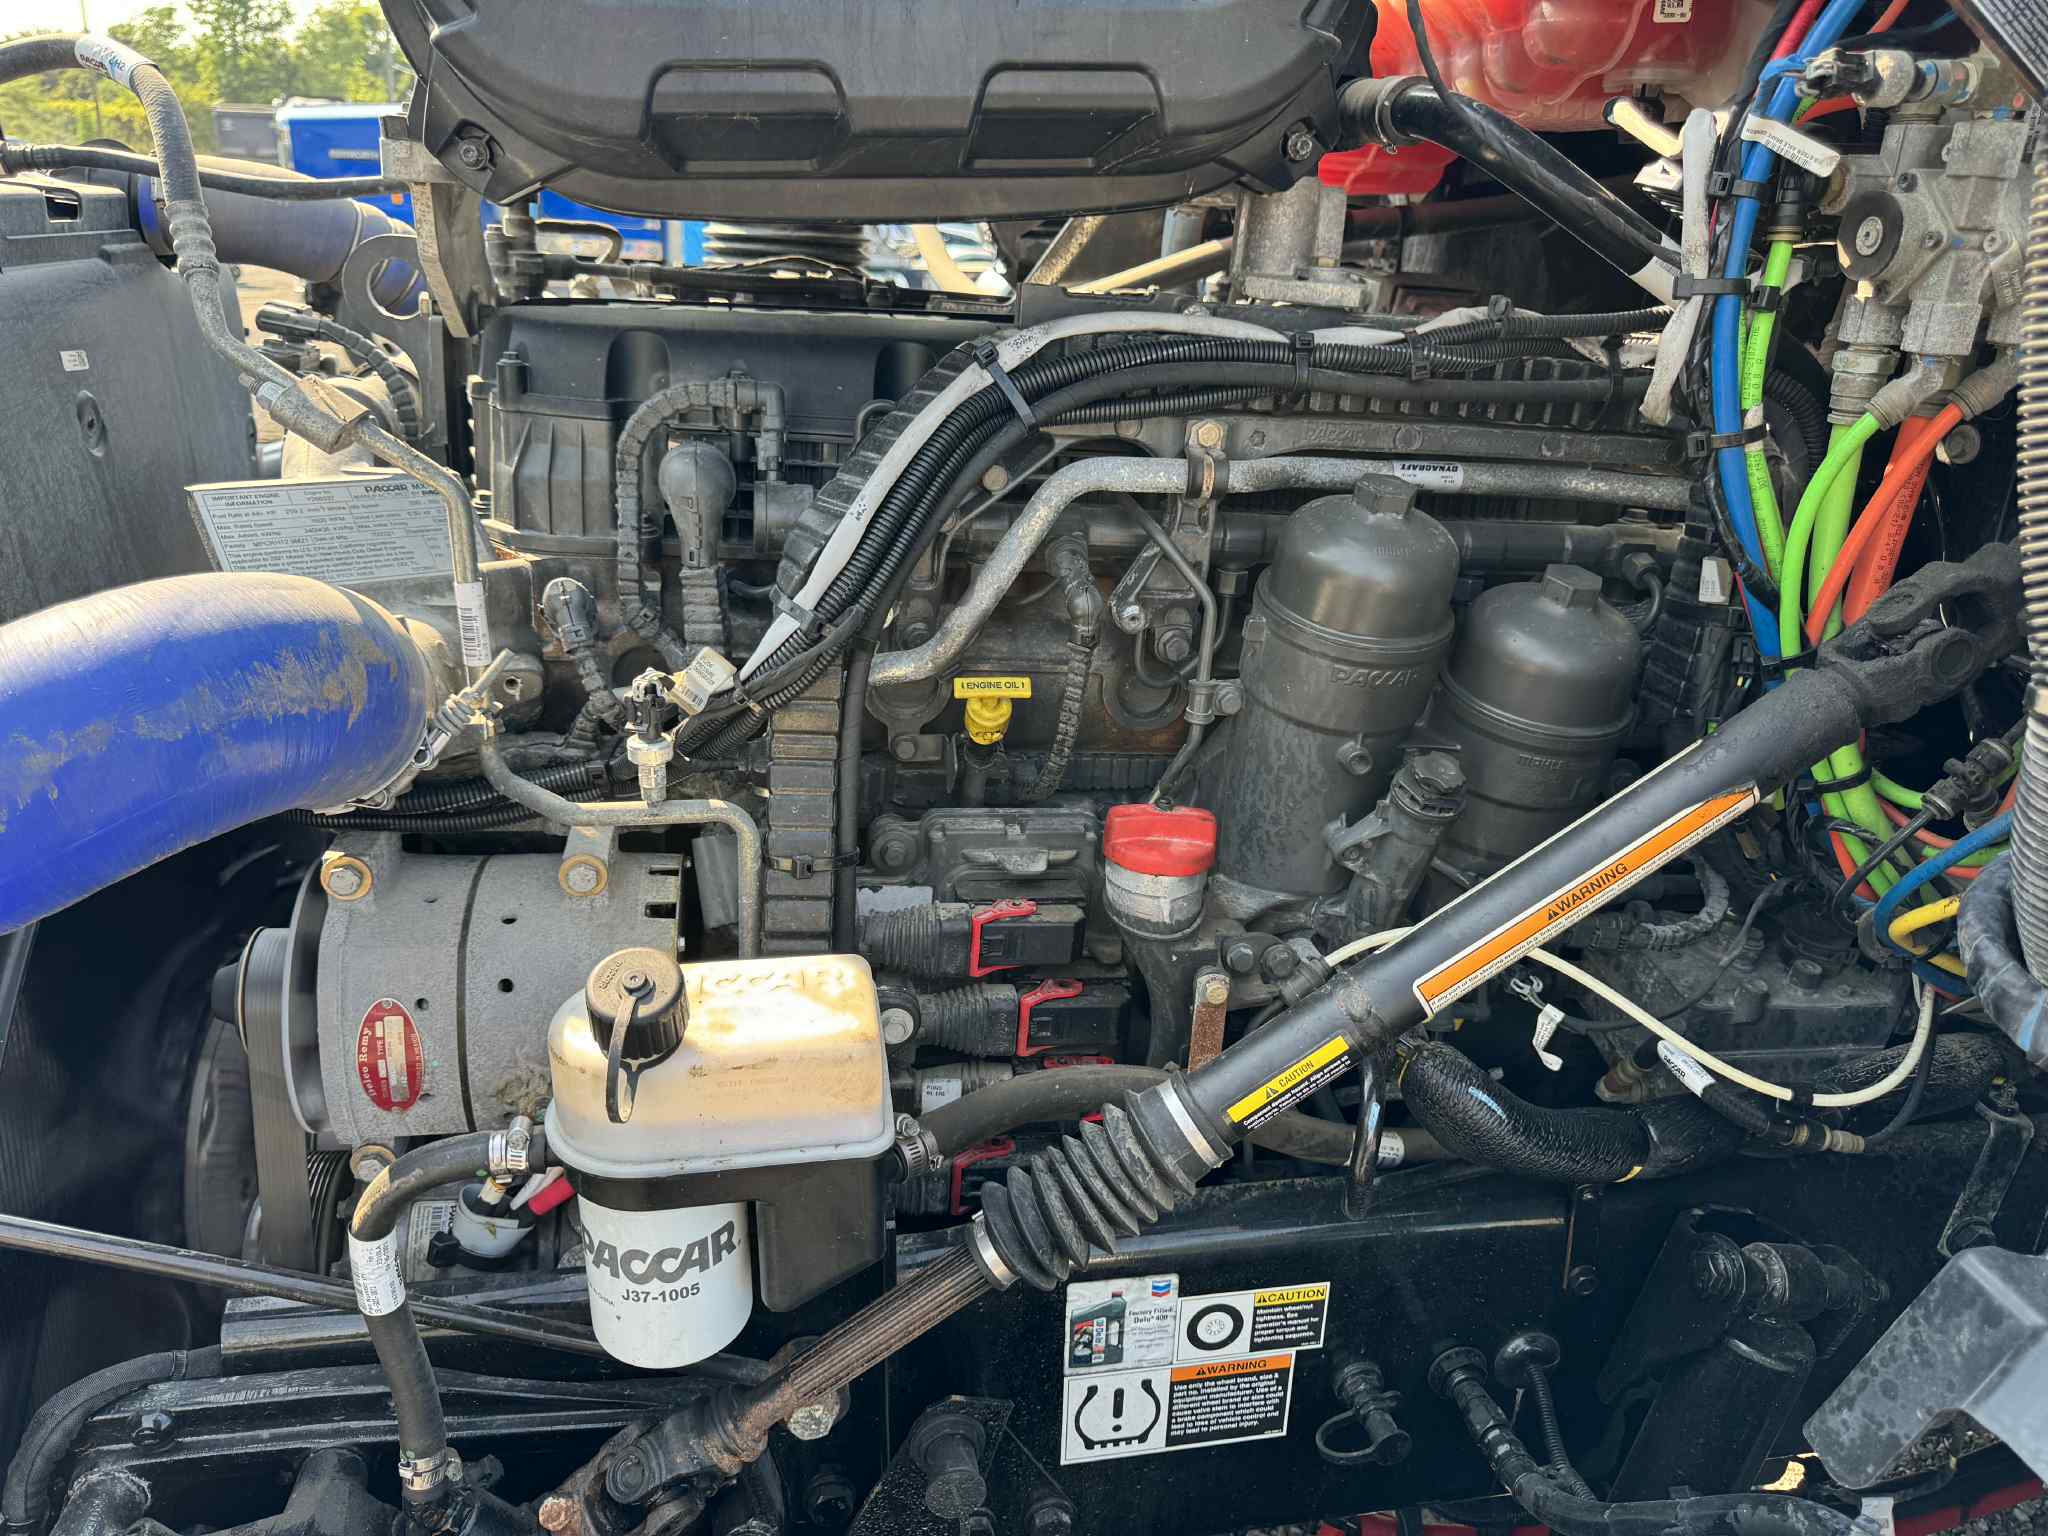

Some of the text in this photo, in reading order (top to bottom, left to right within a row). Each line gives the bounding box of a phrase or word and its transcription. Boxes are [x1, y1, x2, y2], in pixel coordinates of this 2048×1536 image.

[364, 484, 408, 493] PACCAR
[1329, 664, 1417, 688] PACCAR
[966, 681, 1019, 689] ENGINE OIL
[1555, 862, 1628, 913] WARNING
[360, 1028, 376, 1097] Delco Remy
[1279, 1060, 1314, 1088] CAUTION
[581, 1220, 737, 1285] PACCAR
[622, 1282, 700, 1303] J37-1005
[1268, 1288, 1326, 1303] CAUTION
[1256, 1304, 1313, 1315] Maintain wheel/nut
[1255, 1322, 1286, 1330] operator's
[1287, 1318, 1309, 1326] manual
[1256, 1315, 1285, 1323] tightness.
[1276, 1326, 1295, 1334] torque
[1254, 1332, 1315, 1344] tightening sequence.
[1204, 1360, 1267, 1375] WARNING
[1217, 1378, 1235, 1386] wheel
[1172, 1395, 1207, 1404] equipment
[1210, 1389, 1254, 1400] manufacturer.
[1174, 1391, 1186, 1399] part
[1200, 1386, 1232, 1394] installed
[1251, 1380, 1276, 1389] original
[1172, 1401, 1200, 1410] different
[1222, 1396, 1241, 1404] brand
[1197, 1410, 1234, 1421] component
[1235, 1408, 1255, 1416] which
[1209, 1423, 1238, 1433] personal
[1240, 1420, 1259, 1429] injury.
